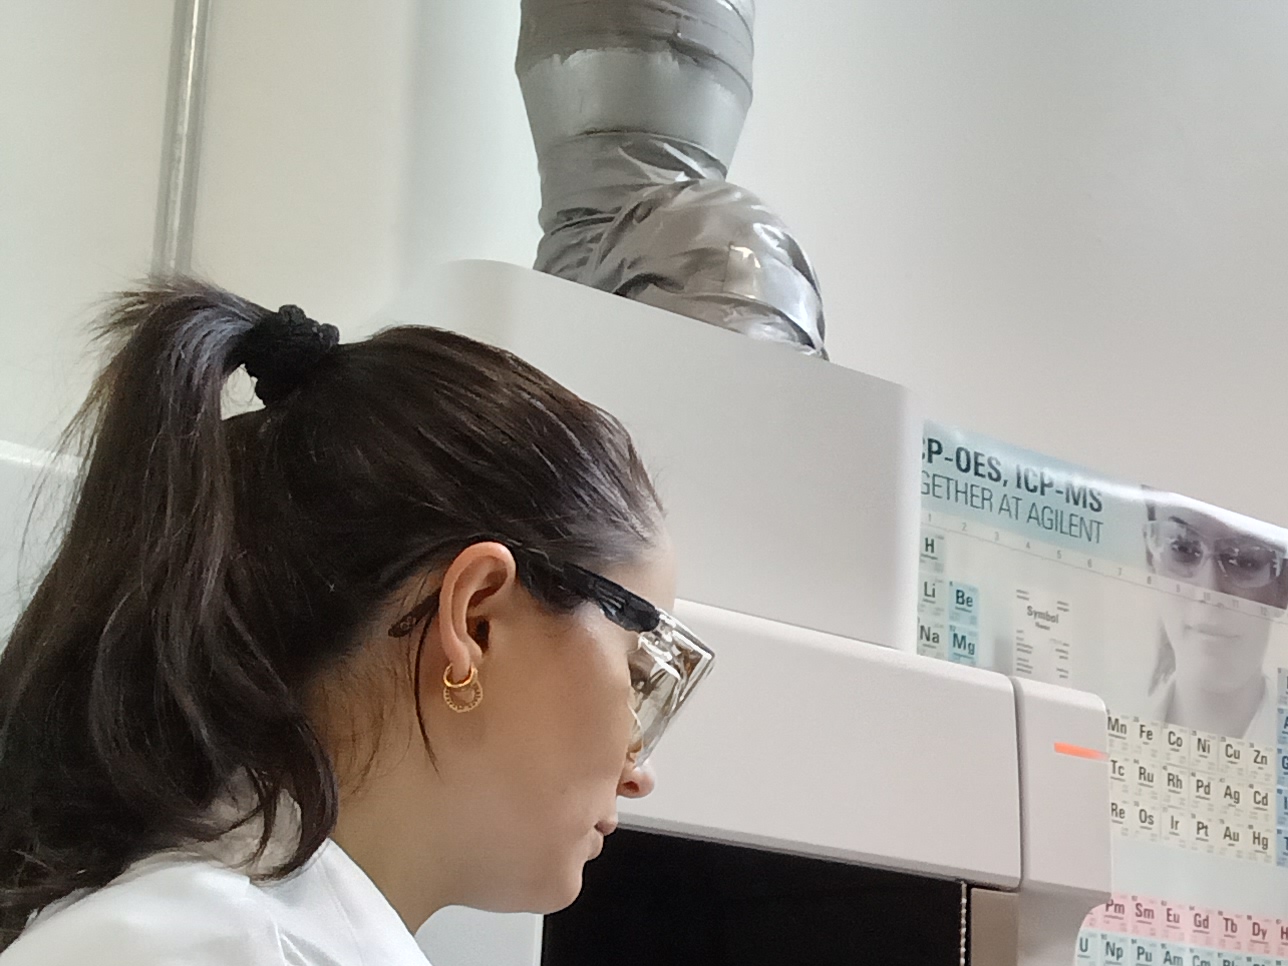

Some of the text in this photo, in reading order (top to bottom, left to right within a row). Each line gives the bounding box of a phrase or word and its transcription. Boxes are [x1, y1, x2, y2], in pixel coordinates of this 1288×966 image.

[1016, 464, 1103, 513] ICP-MS
[961, 522, 967, 531] 2
[998, 494, 1022, 521] AT
[1026, 502, 1104, 544] AGILENT
[924, 537, 935, 554] H
[924, 581, 974, 608] Li Be
[1027, 605, 1059, 624] Symbol
[920, 624, 976, 656] Na Mg
[1107, 716, 1127, 734] Mn
[1139, 724, 1153, 741] Fe
[1168, 731, 1183, 748] Co
[1197, 738, 1210, 754] Ni
[1225, 743, 1241, 760] Cu
[1253, 749, 1268, 765] Zn
[1110, 759, 1125, 777] Tc
[1138, 766, 1154, 783] Ru
[1167, 772, 1183, 790] Rh
[1196, 779, 1211, 795] Pd
[1223, 785, 1241, 804] Ag
[1253, 790, 1268, 807] Cd
[1111, 802, 1125, 819] Re
[1138, 808, 1154, 825] Os
[1170, 815, 1179, 830] Ir
[1196, 821, 1209, 837] Pt
[1223, 826, 1240, 842] Au
[1252, 831, 1268, 850] Hg
[1105, 899, 1125, 915] Pm
[1135, 902, 1155, 919] Sm
[1166, 907, 1180, 924] Eu
[1193, 912, 1209, 930] Gd
[1223, 916, 1238, 933] Tb
[1252, 921, 1268, 941] Dy
[1080, 936, 1089, 953] U
[1105, 941, 1124, 961] Np
[1137, 946, 1153, 963] Pu
[1163, 950, 1184, 966] Am
